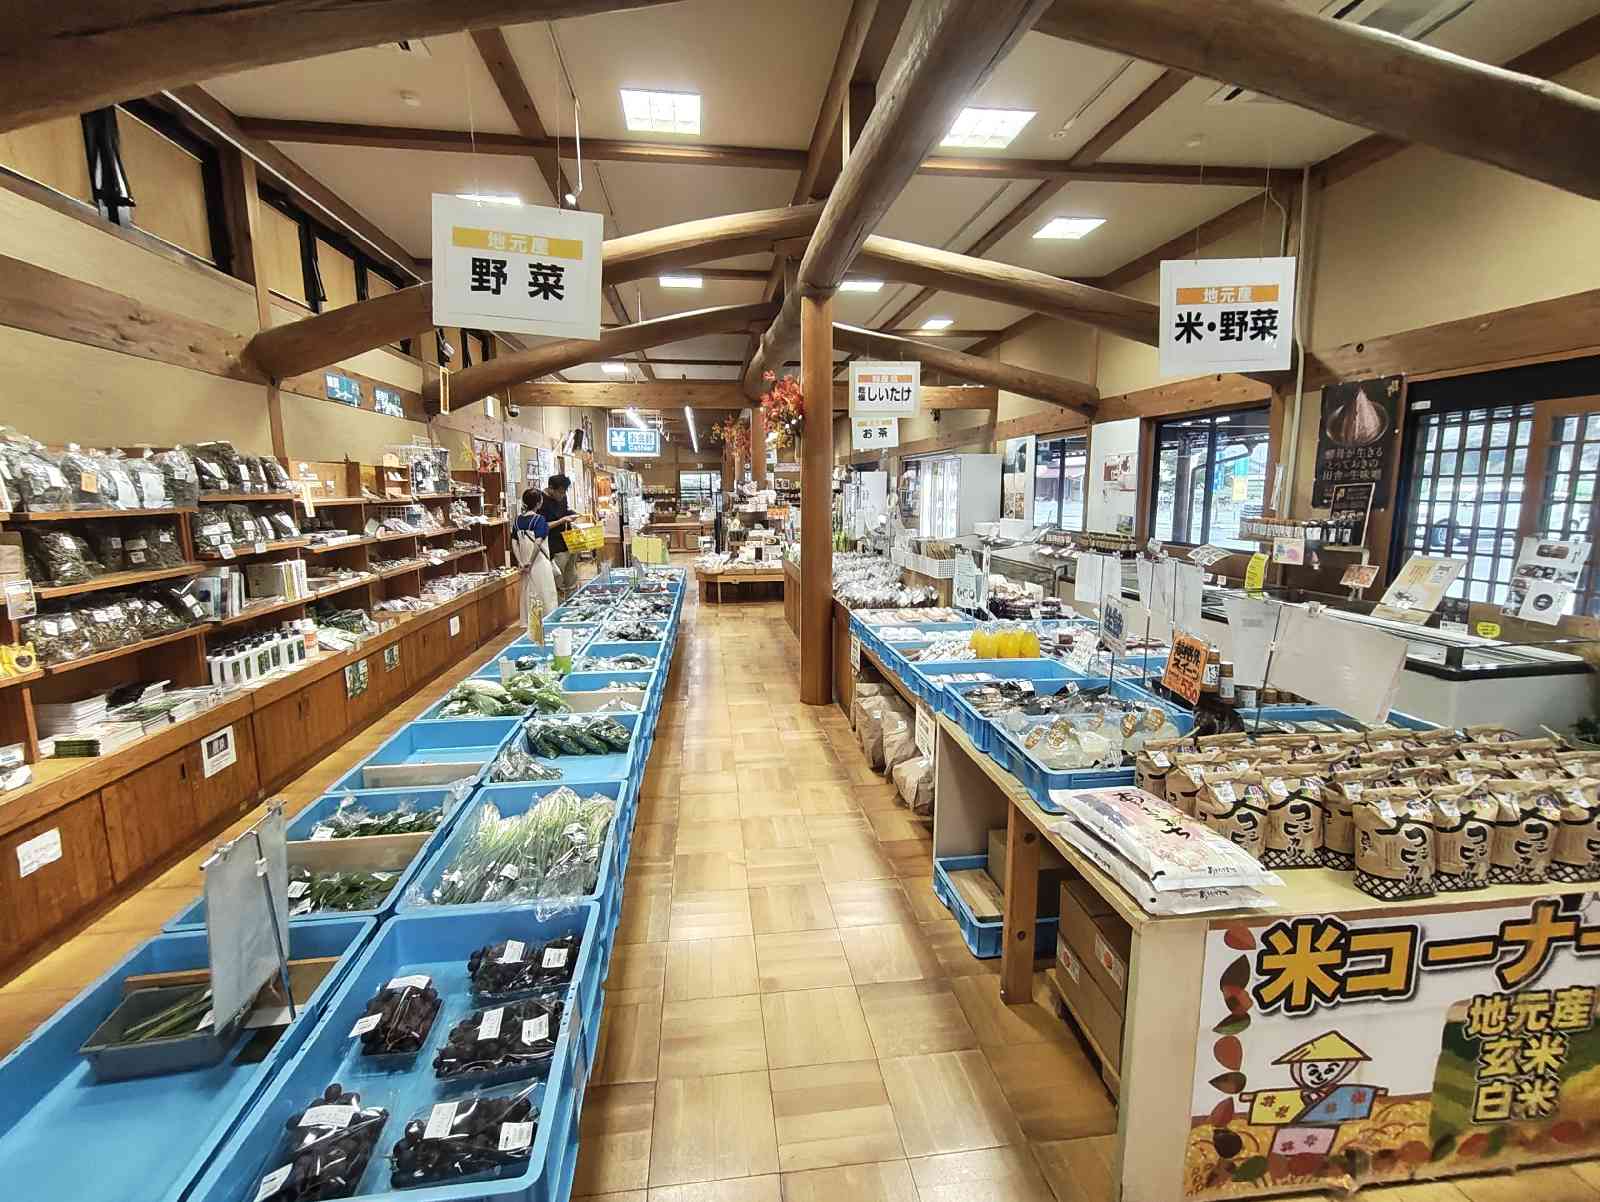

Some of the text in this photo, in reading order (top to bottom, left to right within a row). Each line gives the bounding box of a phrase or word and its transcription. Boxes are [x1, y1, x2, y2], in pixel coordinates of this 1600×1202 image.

[487, 230, 551, 256] 地元産
[470, 256, 565, 301] 野菜
[1202, 286, 1252, 304] 地元産
[1174, 309, 1278, 344] 米・野菜
[862, 427, 888, 439] お茶
[1464, 985, 1597, 1040] 地元産
[1476, 1034, 1568, 1080] 玄米
[1473, 1078, 1560, 1122] 白米
